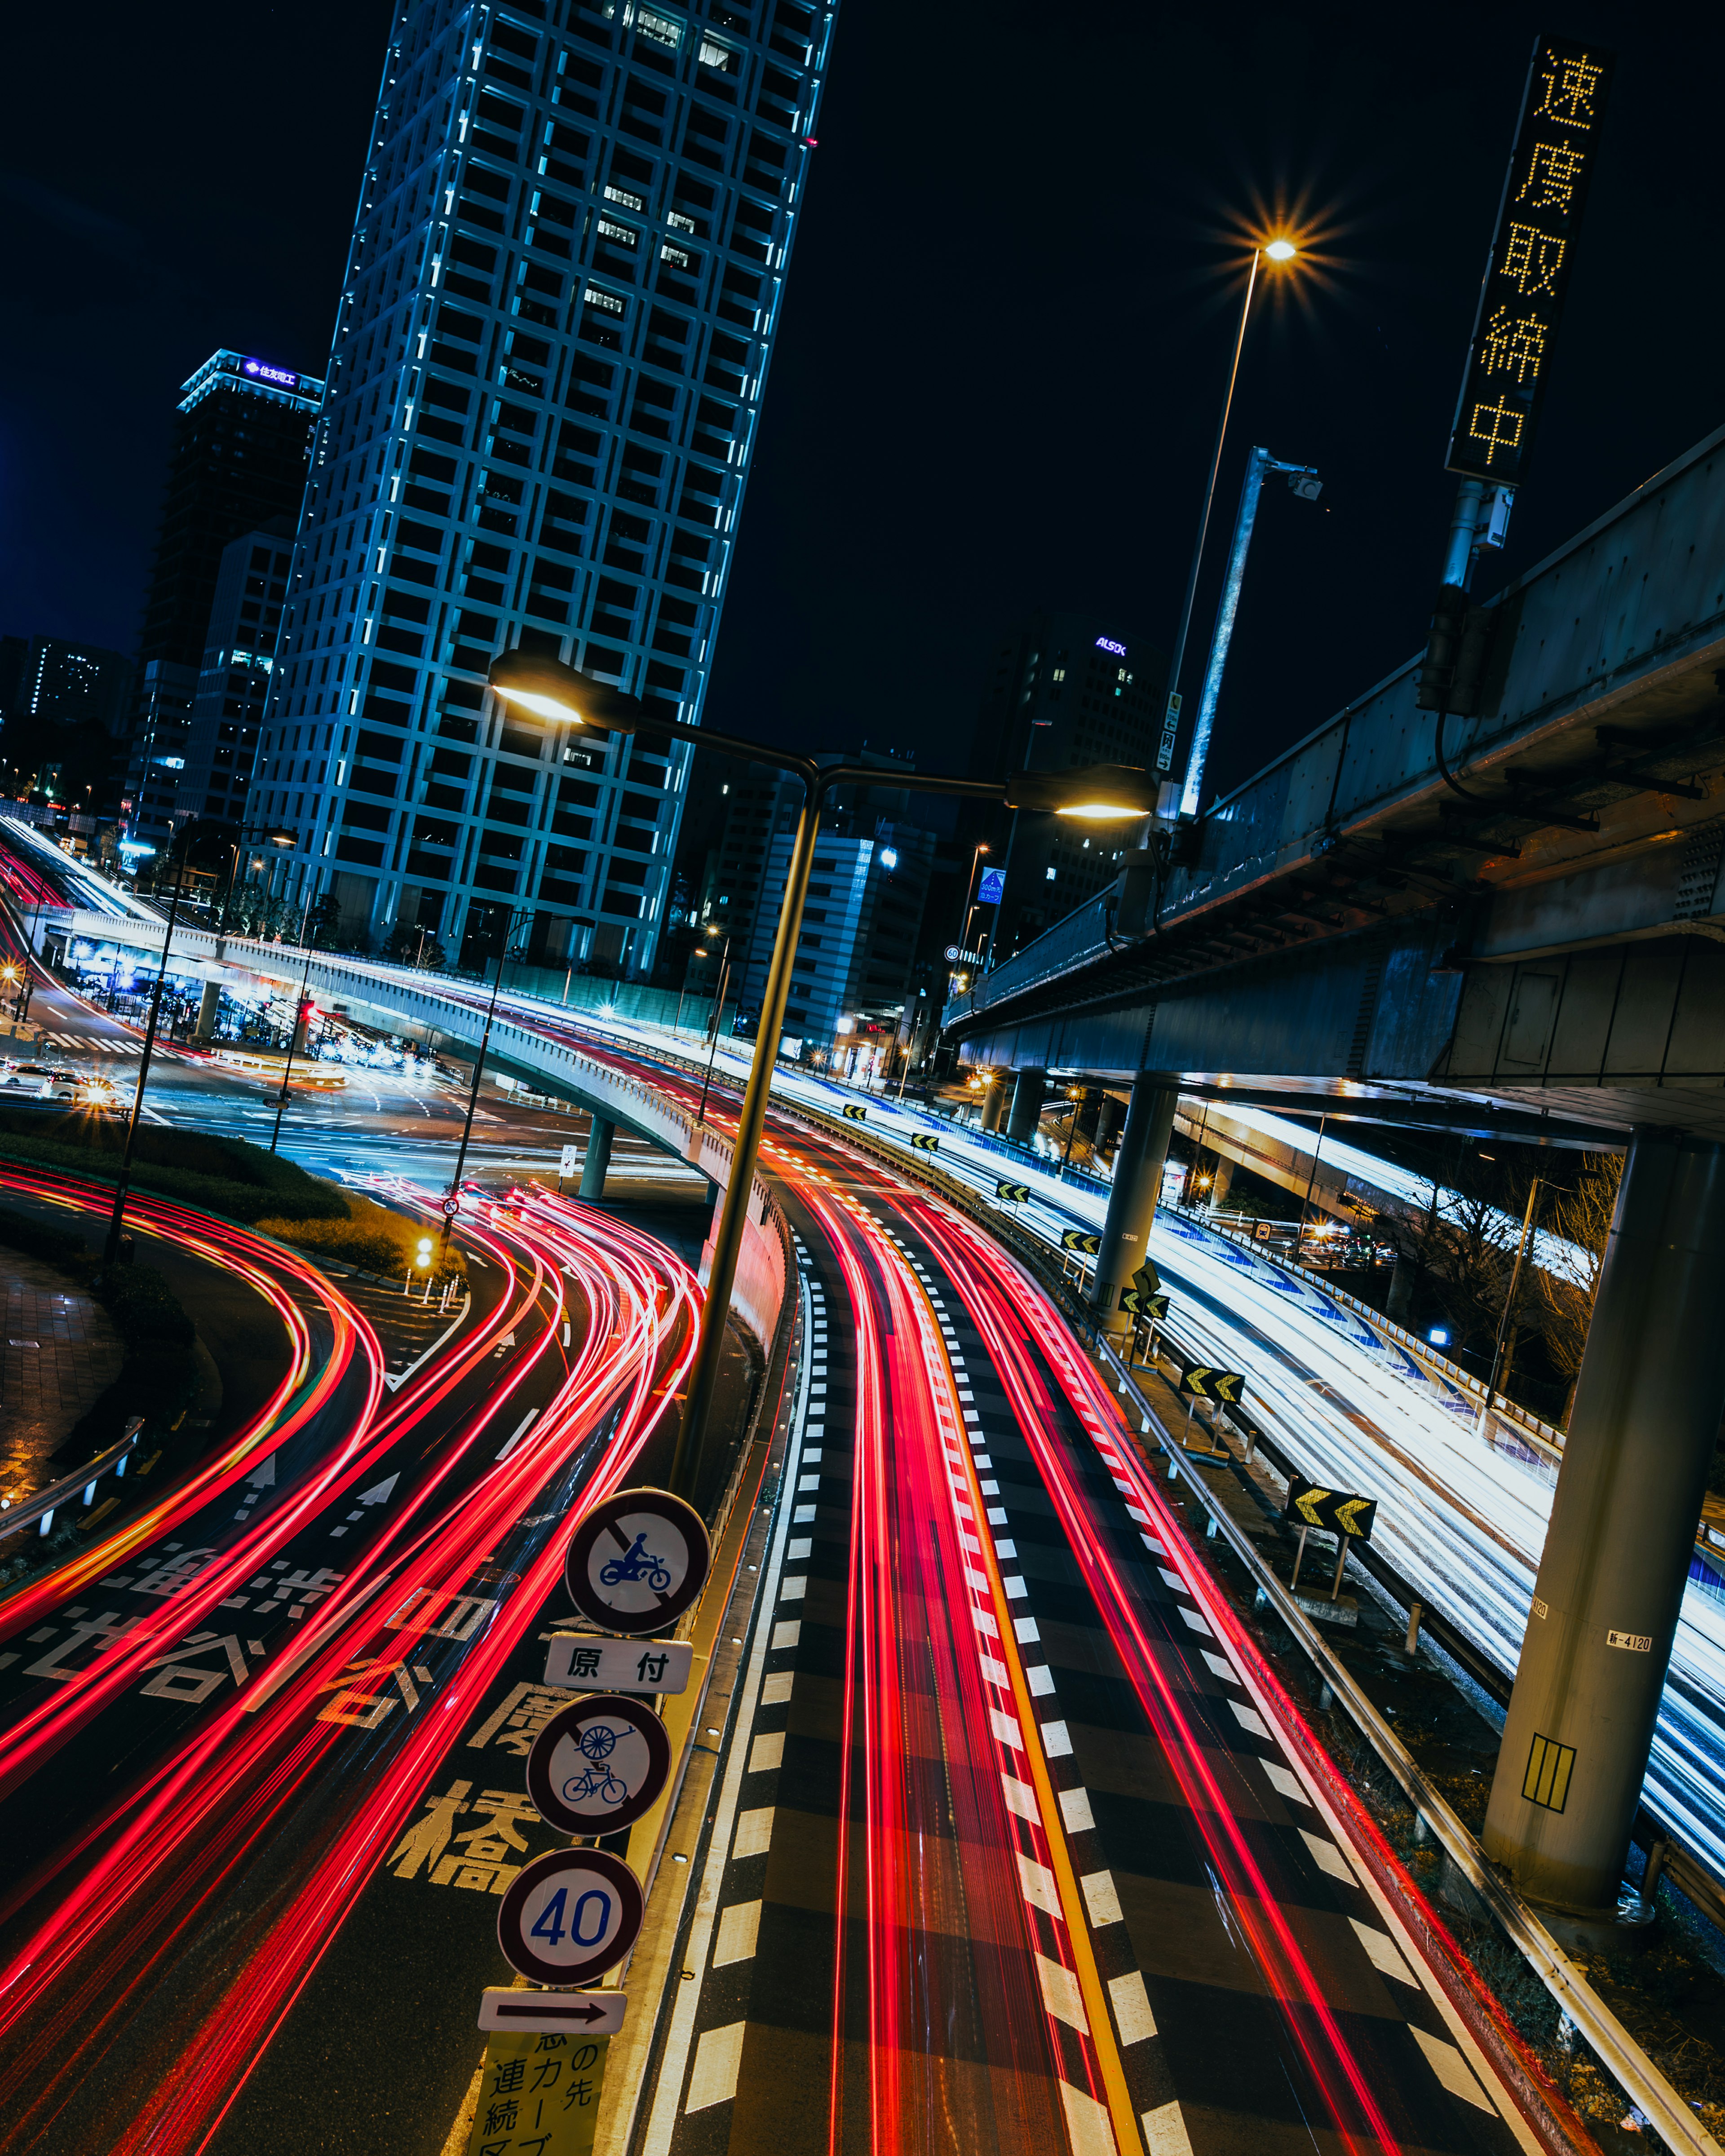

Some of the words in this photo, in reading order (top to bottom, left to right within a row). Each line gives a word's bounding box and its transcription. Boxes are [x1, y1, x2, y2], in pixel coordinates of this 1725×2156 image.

[1468, 48, 1603, 465] 速度取締中
[260, 365, 296, 385] 住友電工
[1096, 637, 1126, 657] ALSOK
[948, 949, 957, 957] 60
[1609, 1632, 1650, 1650] 新-4120
[567, 1647, 669, 1682] 原付
[531, 1888, 611, 1947] 40
